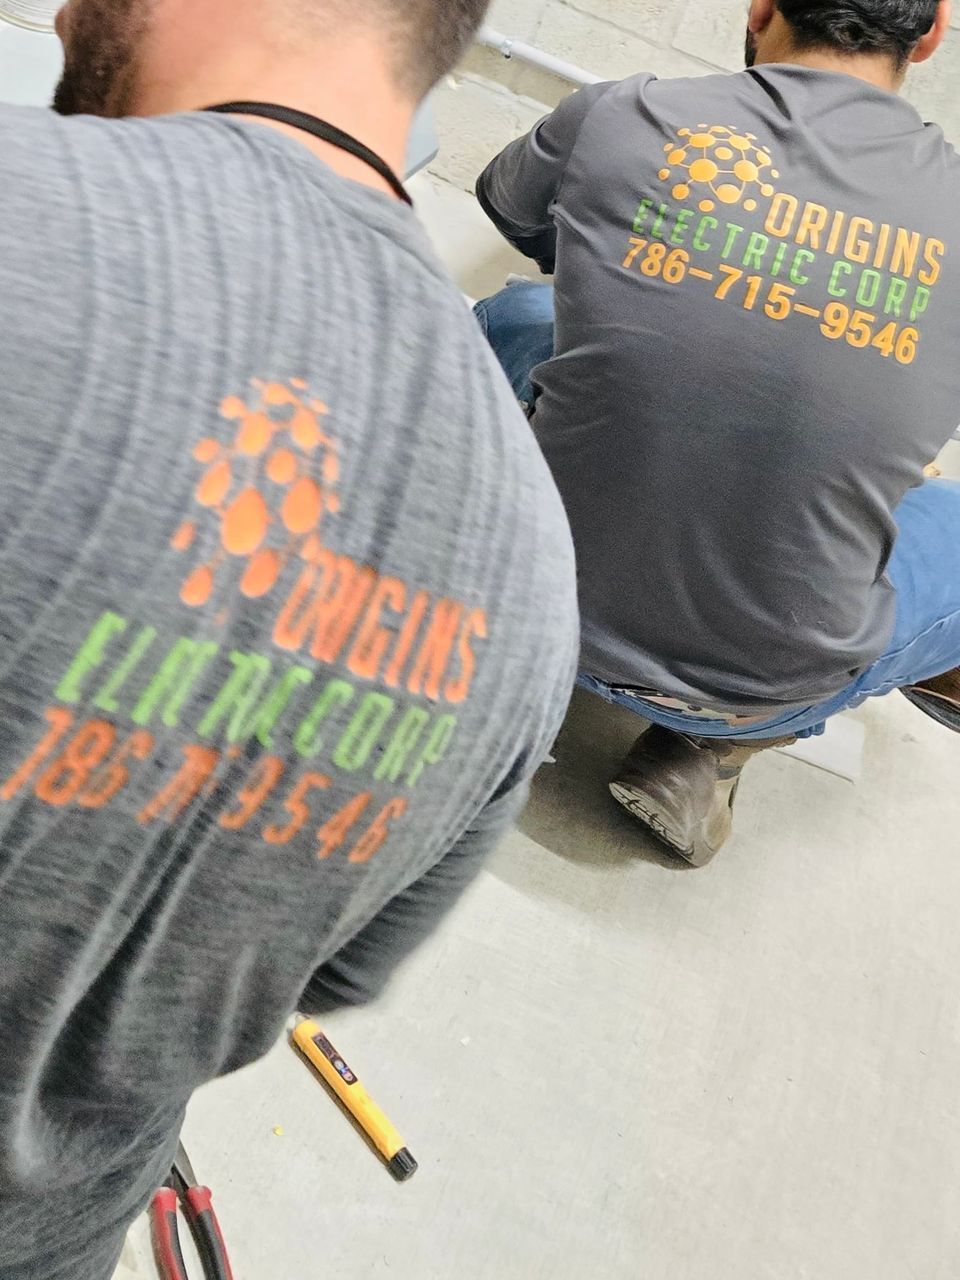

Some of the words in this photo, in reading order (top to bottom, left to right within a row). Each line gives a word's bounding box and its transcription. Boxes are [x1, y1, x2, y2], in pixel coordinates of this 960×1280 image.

[622, 236, 920, 366] 786-715-9546
[631, 198, 816, 285] ELECTRIC
[827, 260, 930, 322] CORP
[764, 192, 945, 287] ORIGINS
